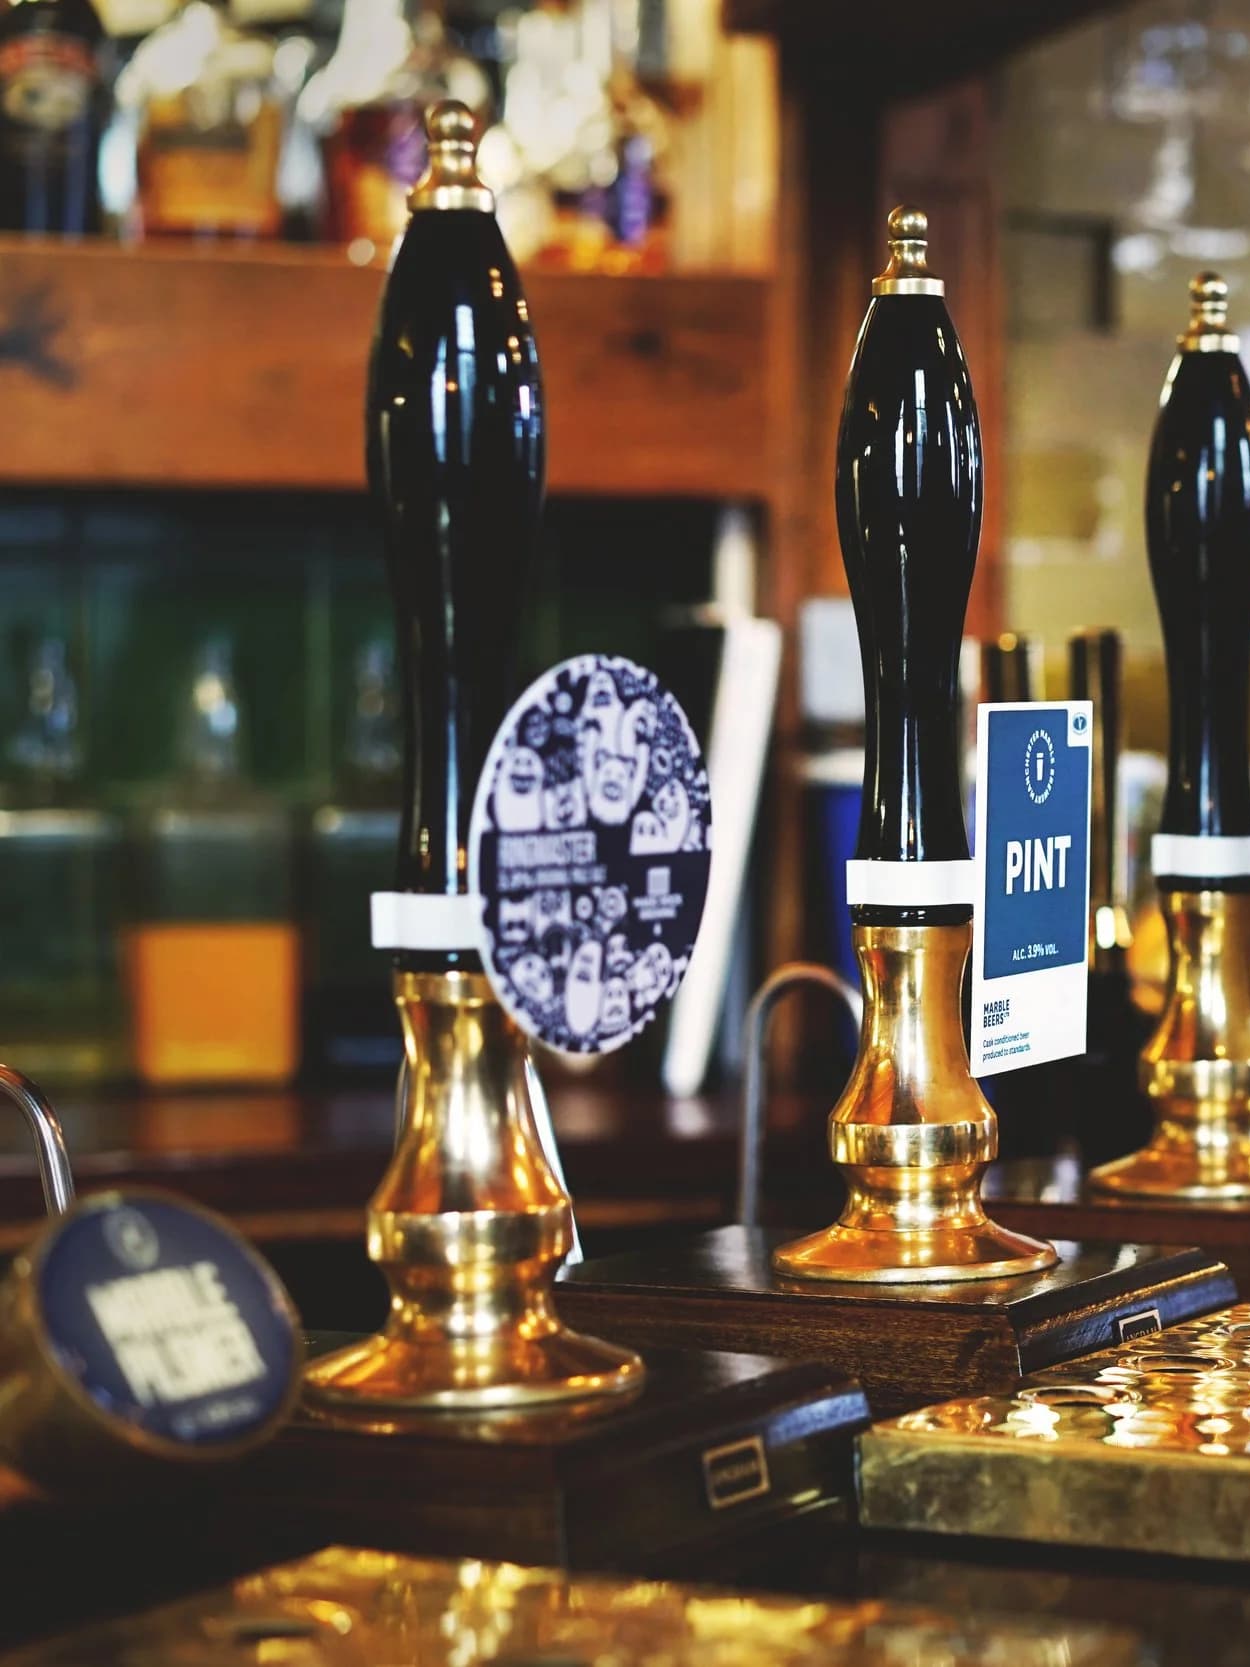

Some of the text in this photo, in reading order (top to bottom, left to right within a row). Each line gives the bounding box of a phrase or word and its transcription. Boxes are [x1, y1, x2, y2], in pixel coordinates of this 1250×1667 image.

[1006, 834, 1072, 895] PINT
[1012, 948, 1027, 961] ALC.
[1027, 943, 1045, 959] 3.9%
[984, 999, 1010, 1015] MARBLE
[984, 1013, 1004, 1028] BEERS
[983, 1047, 1003, 1063] produced
